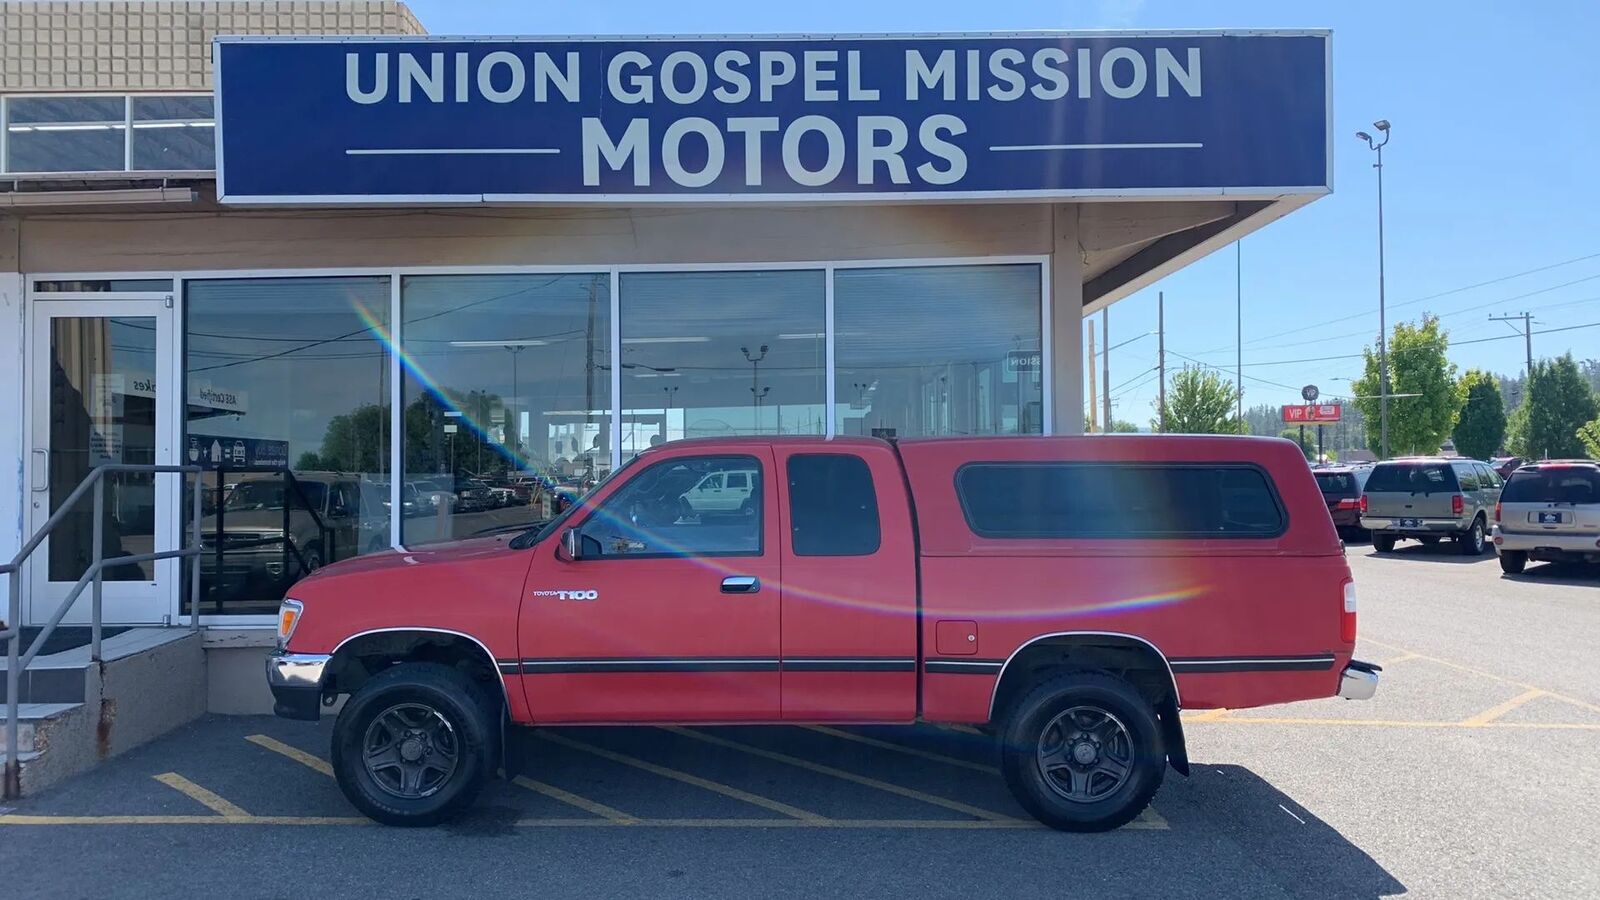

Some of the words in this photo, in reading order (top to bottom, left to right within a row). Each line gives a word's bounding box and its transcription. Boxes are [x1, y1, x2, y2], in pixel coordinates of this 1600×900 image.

[346, 51, 580, 105] UNION
[607, 50, 880, 105] GOSPEL
[905, 46, 1202, 101] MISSION
[582, 114, 968, 188] MOTORS
[1289, 408, 1303, 419] VIP
[558, 590, 599, 600] T100
